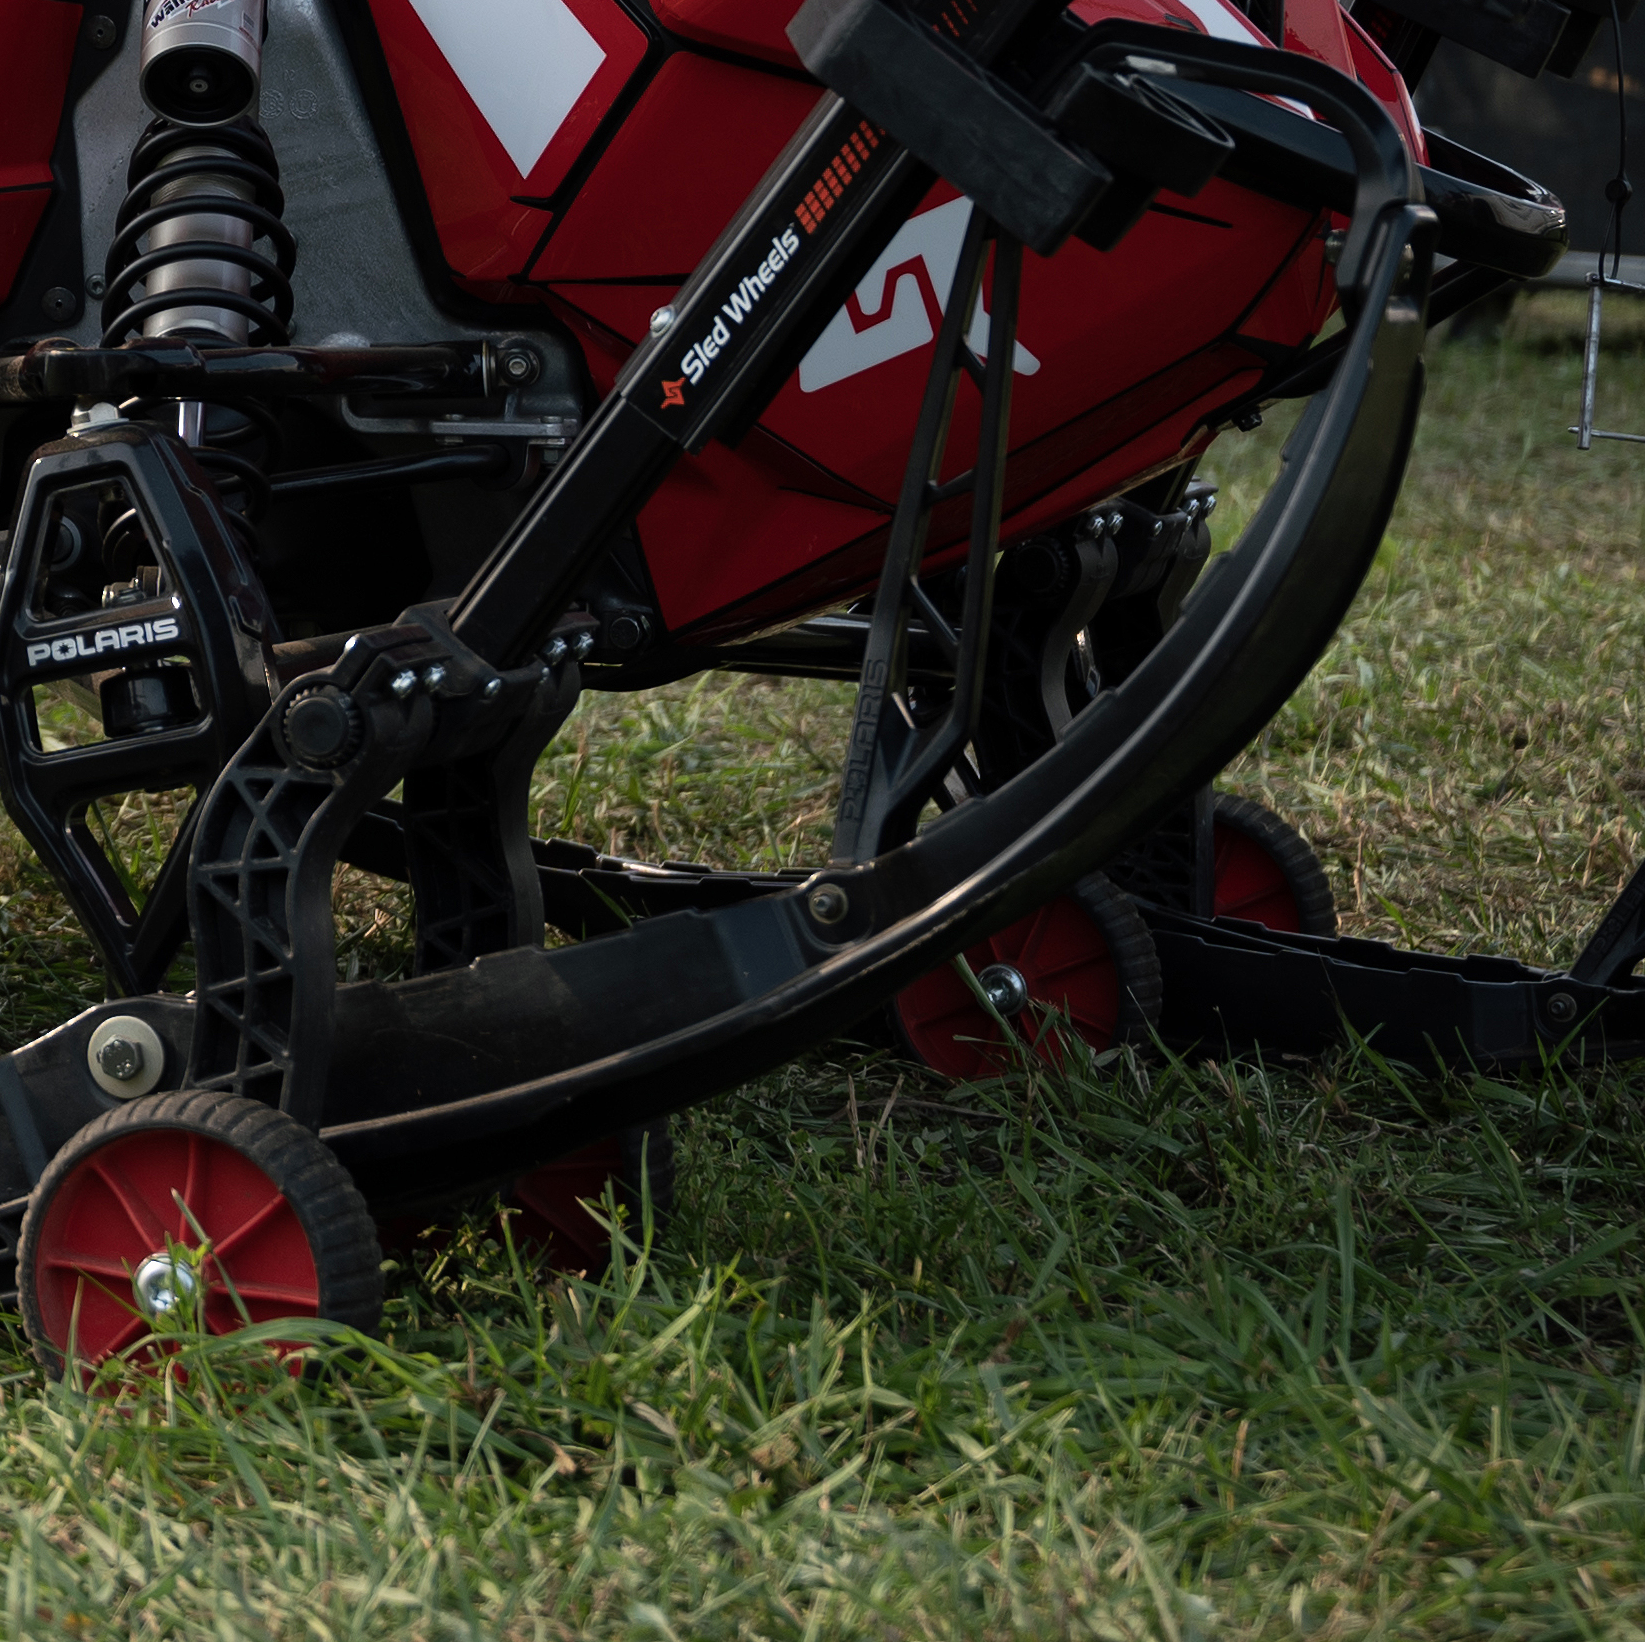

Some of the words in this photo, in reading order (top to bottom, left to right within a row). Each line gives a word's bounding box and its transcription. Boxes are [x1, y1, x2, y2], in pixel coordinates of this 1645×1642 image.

[680, 315, 731, 386] Sled
[721, 227, 800, 325] Wheels
[26, 617, 179, 667] POLARIS
[839, 658, 888, 822] POLARIS
